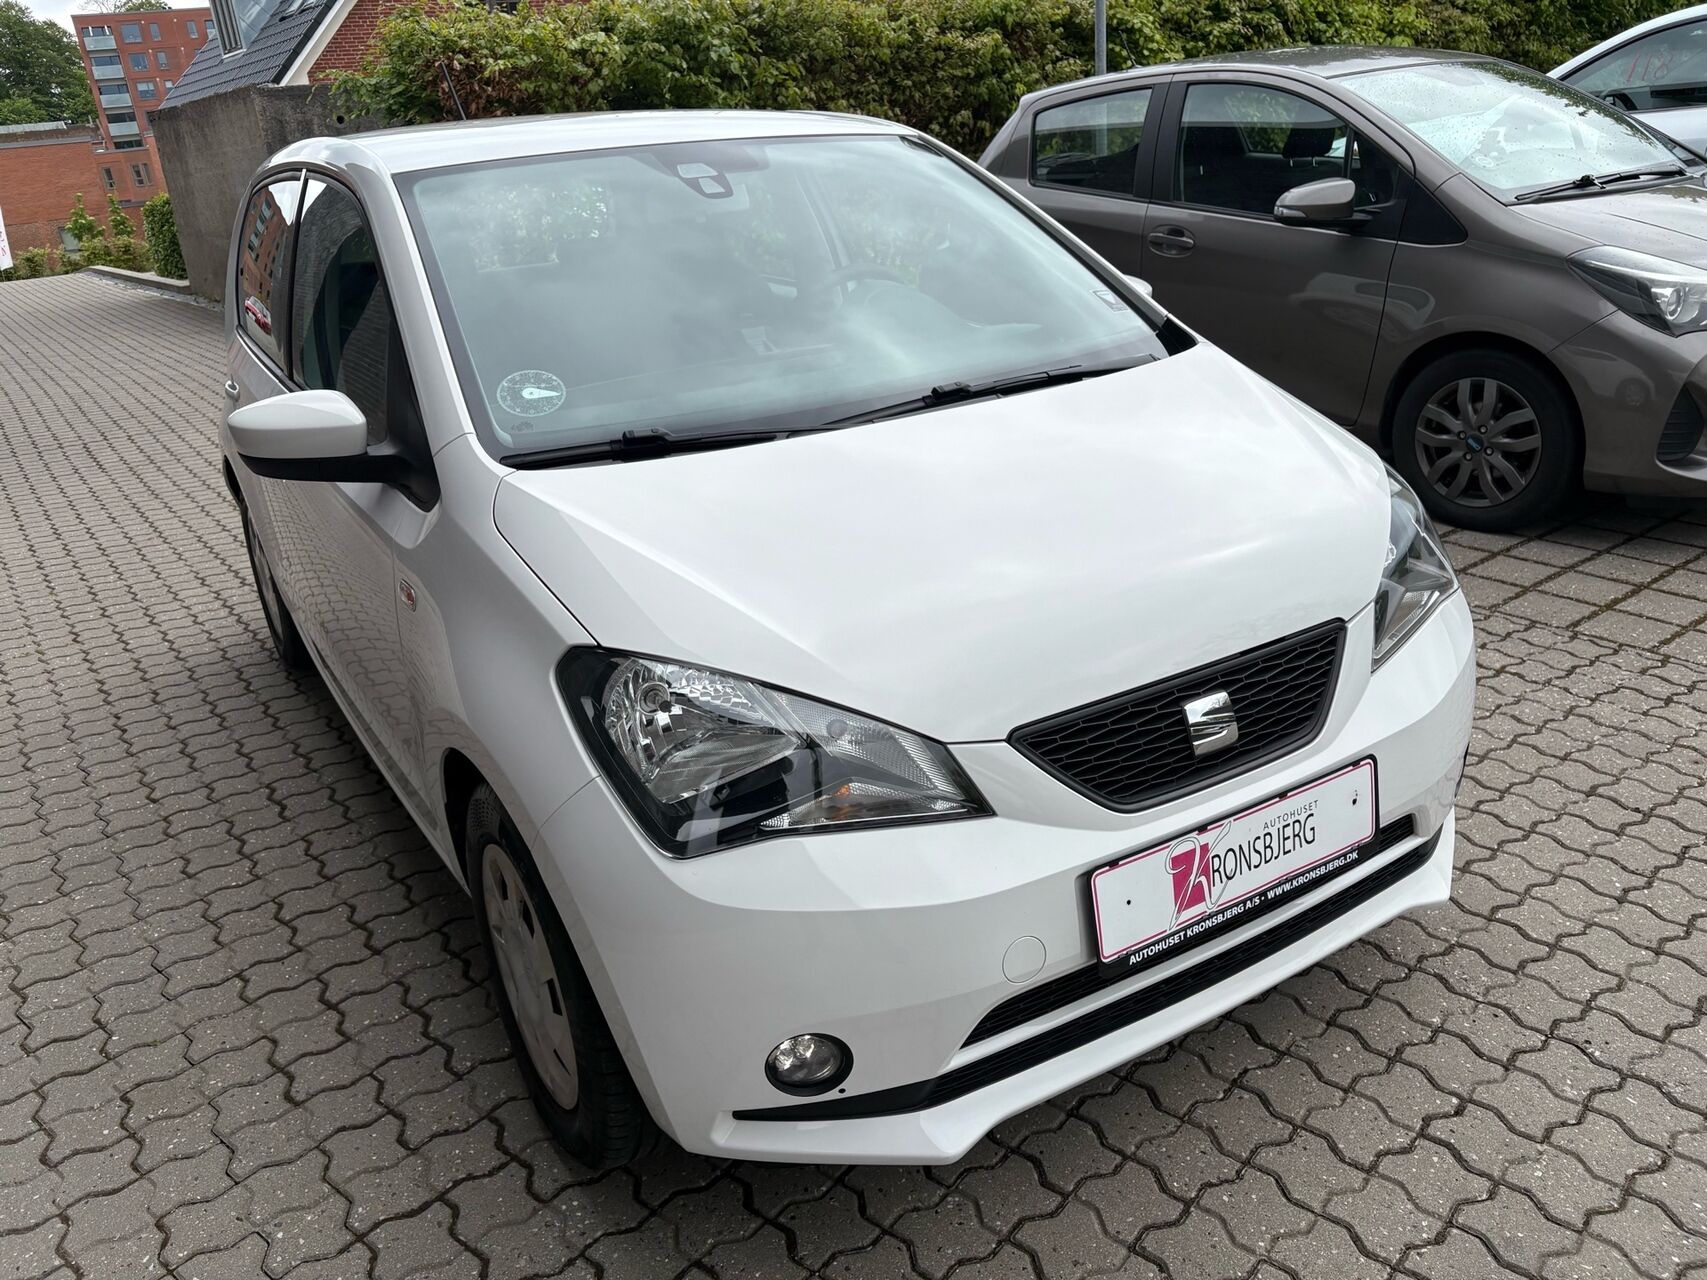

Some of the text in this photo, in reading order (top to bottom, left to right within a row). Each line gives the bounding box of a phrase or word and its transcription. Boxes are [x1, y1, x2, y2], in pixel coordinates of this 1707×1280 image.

[1626, 50, 1674, 82] 118
[1263, 800, 1319, 831] AUTOHUSET
[1129, 850, 1359, 965] AUTOHUSET KRONSBJERG A/S WWW.KRONSBJERG.DK
